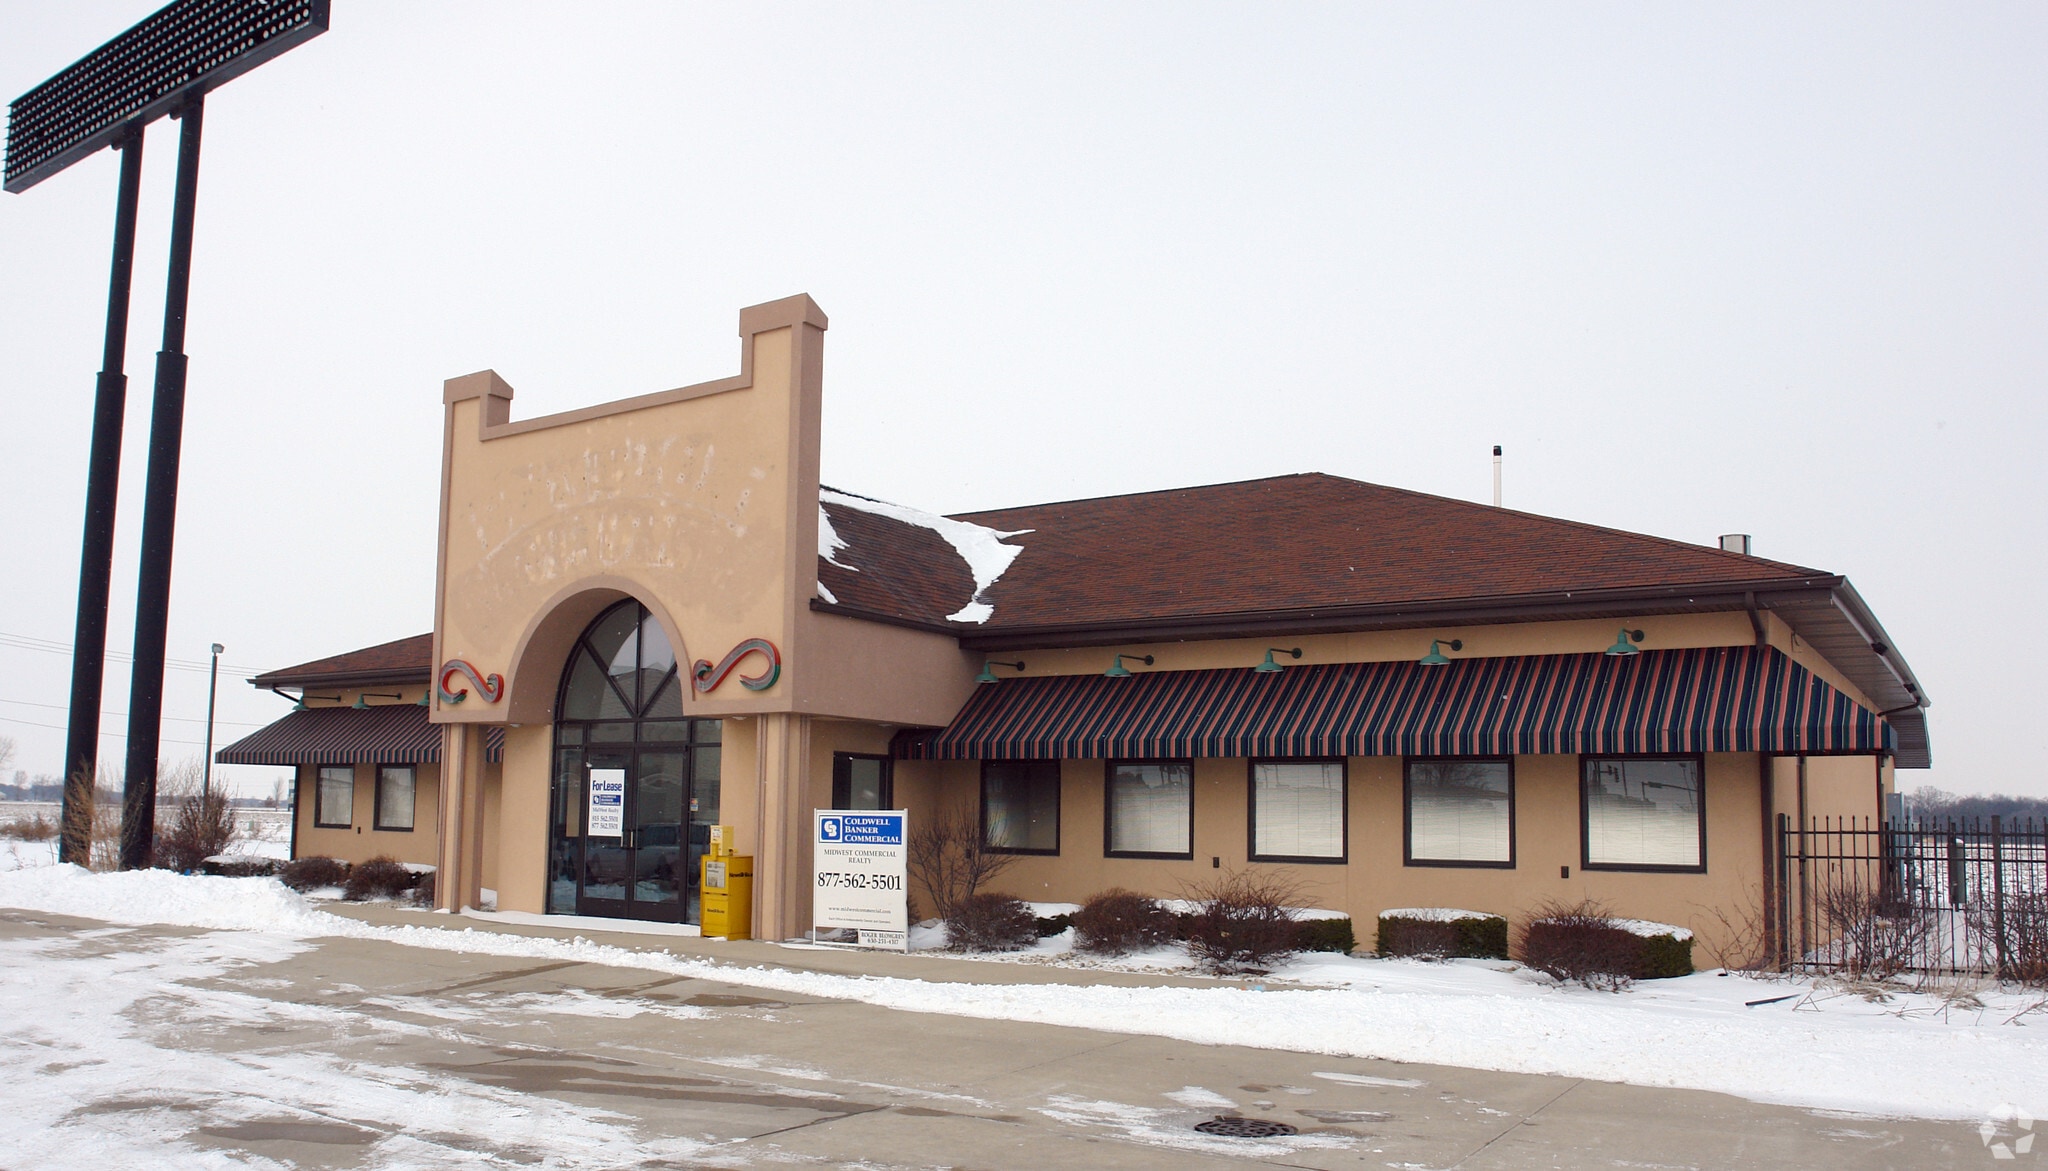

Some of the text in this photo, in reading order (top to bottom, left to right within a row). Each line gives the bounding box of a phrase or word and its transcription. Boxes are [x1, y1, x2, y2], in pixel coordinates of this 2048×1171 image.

[592, 780, 622, 791] For Lease
[844, 817, 890, 826] COLDWELL
[844, 826, 878, 834] BANKER
[844, 834, 901, 843] COMMERCIAL
[818, 872, 902, 890] 877-562-5501
